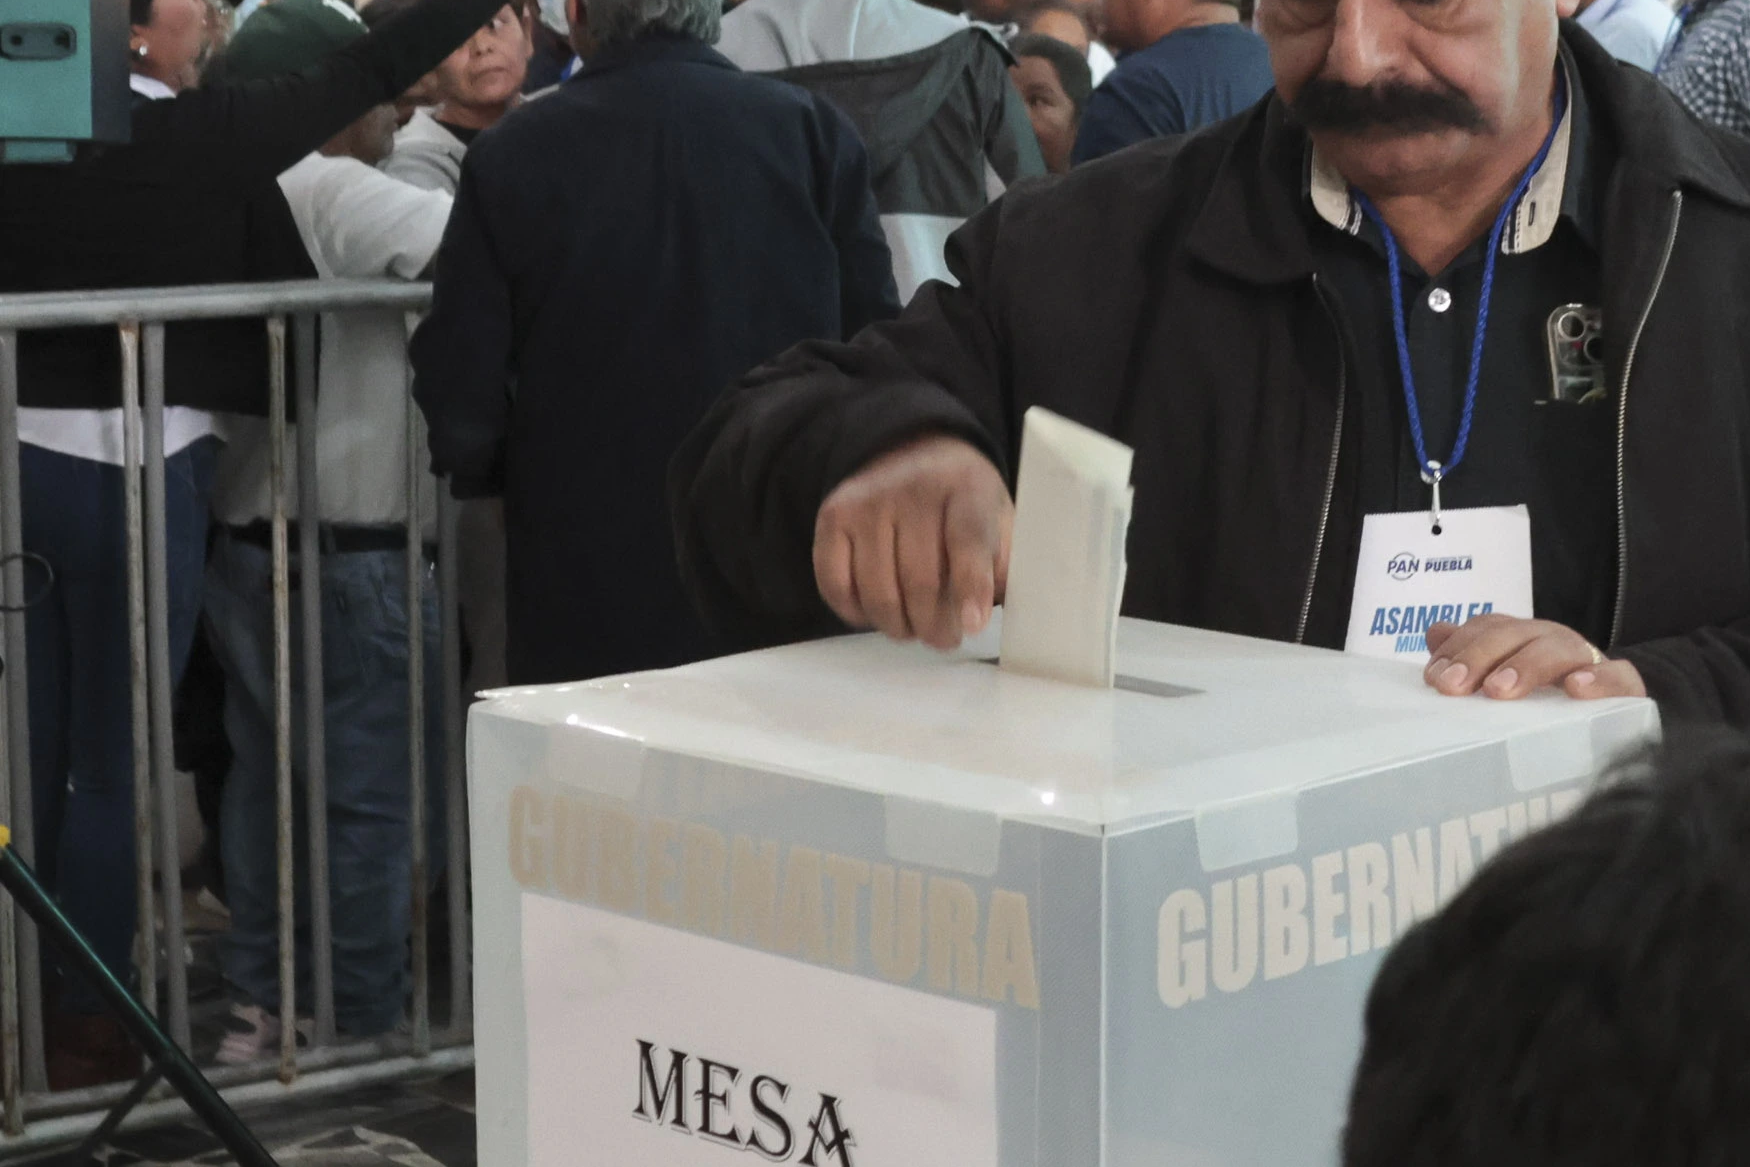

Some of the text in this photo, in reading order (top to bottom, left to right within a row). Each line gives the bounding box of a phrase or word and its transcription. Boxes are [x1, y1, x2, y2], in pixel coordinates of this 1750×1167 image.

[1387, 558, 1473, 573] PAN PUEBLA
[508, 784, 1041, 1009] GUBERNATURA
[632, 1037, 857, 1167] MESA
